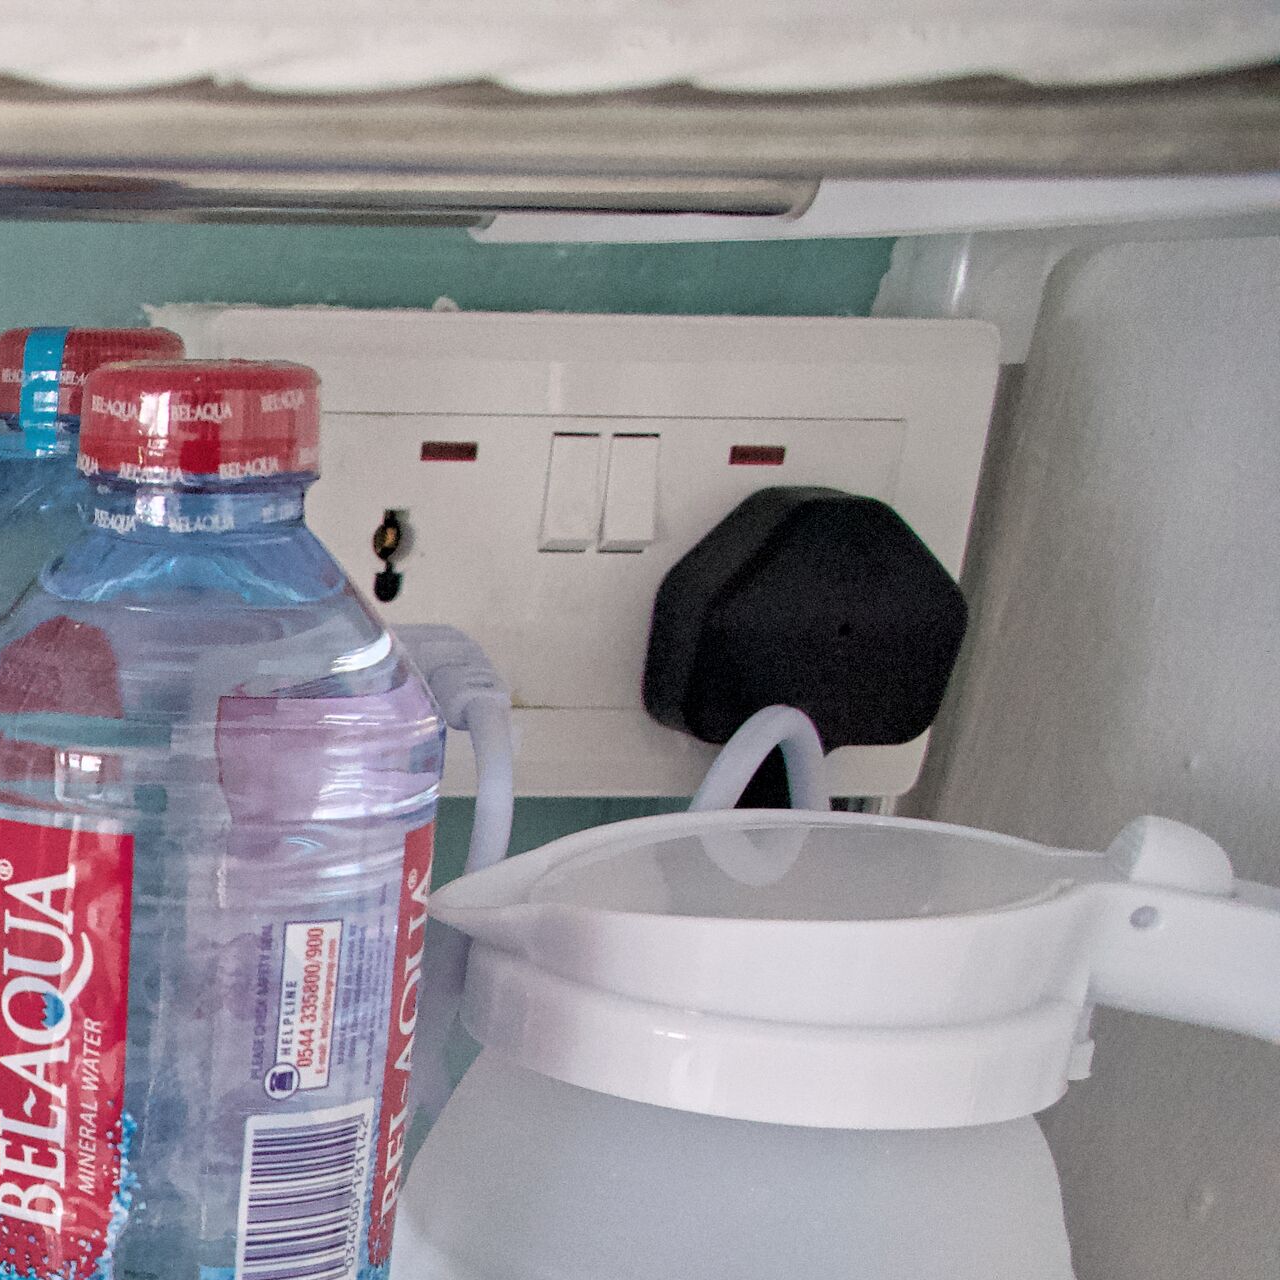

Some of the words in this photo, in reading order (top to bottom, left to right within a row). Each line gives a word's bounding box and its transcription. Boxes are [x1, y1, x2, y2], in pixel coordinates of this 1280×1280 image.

[171, 402, 233, 423] BEL-AQUA
[281, 980, 297, 1056] HELPLINE
[296, 1028, 315, 1068] 0544
[80, 1018, 103, 1096] WATER
[76, 1101, 98, 1196] MINERAL
